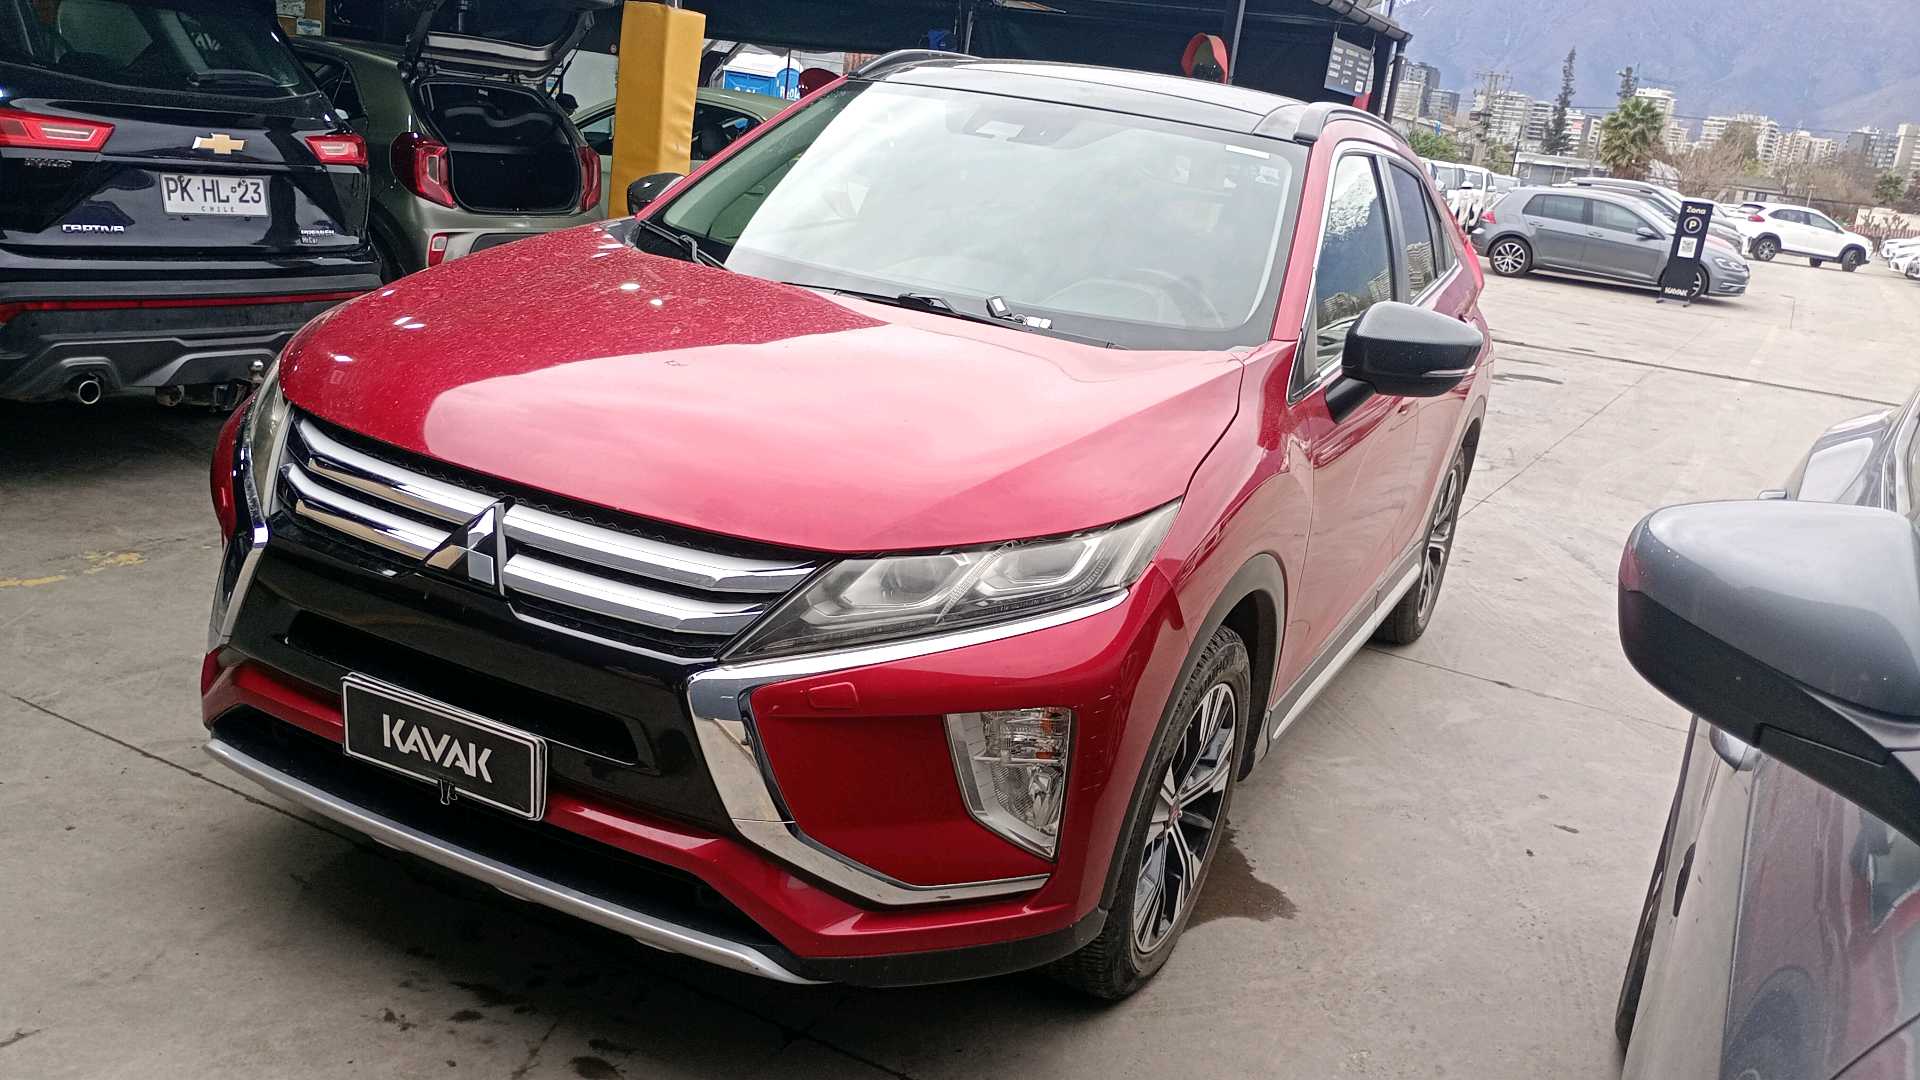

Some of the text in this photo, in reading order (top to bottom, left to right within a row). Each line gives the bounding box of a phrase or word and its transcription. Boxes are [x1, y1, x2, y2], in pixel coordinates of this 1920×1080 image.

[1686, 206, 1706, 215] Zona
[62, 224, 125, 233] CAPTIVA
[1664, 287, 1688, 297] KAVAK
[382, 713, 493, 784] KAVAK
